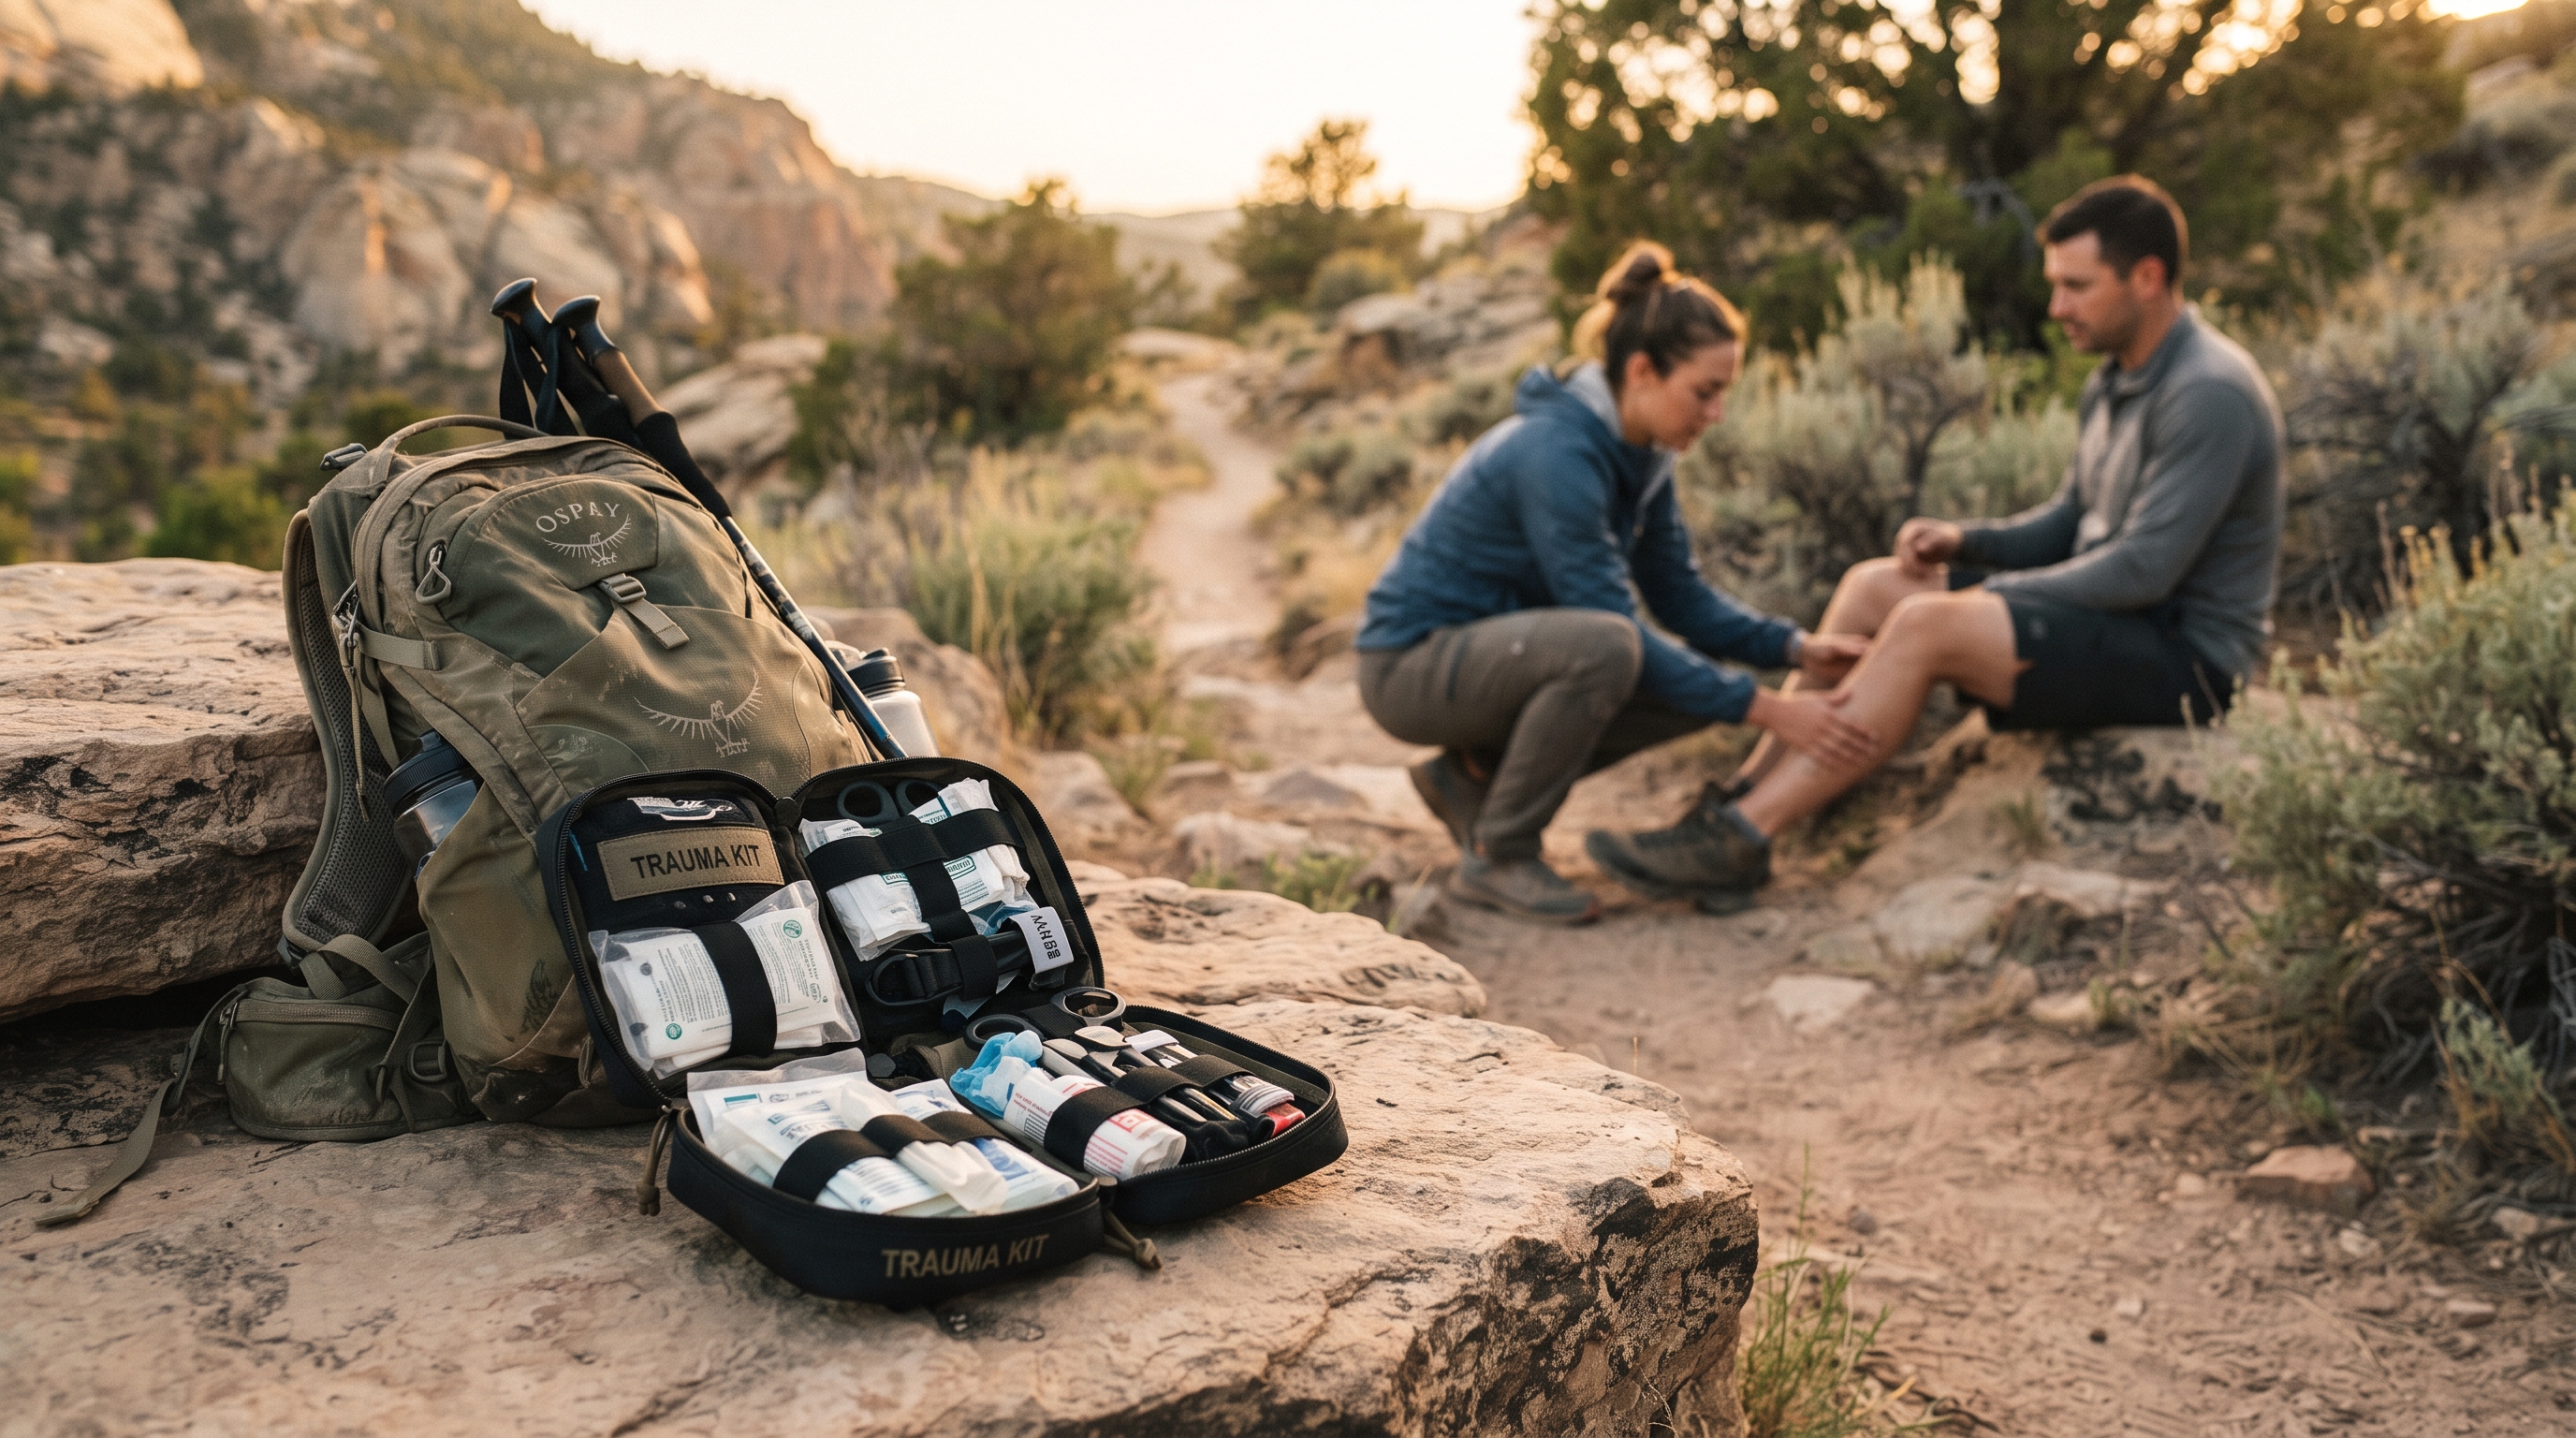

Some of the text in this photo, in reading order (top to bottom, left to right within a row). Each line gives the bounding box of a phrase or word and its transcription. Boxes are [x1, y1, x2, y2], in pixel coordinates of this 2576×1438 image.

[630, 844, 761, 879] TRAUMA KIT
[882, 1233, 1050, 1279] TRAUMA KIT
